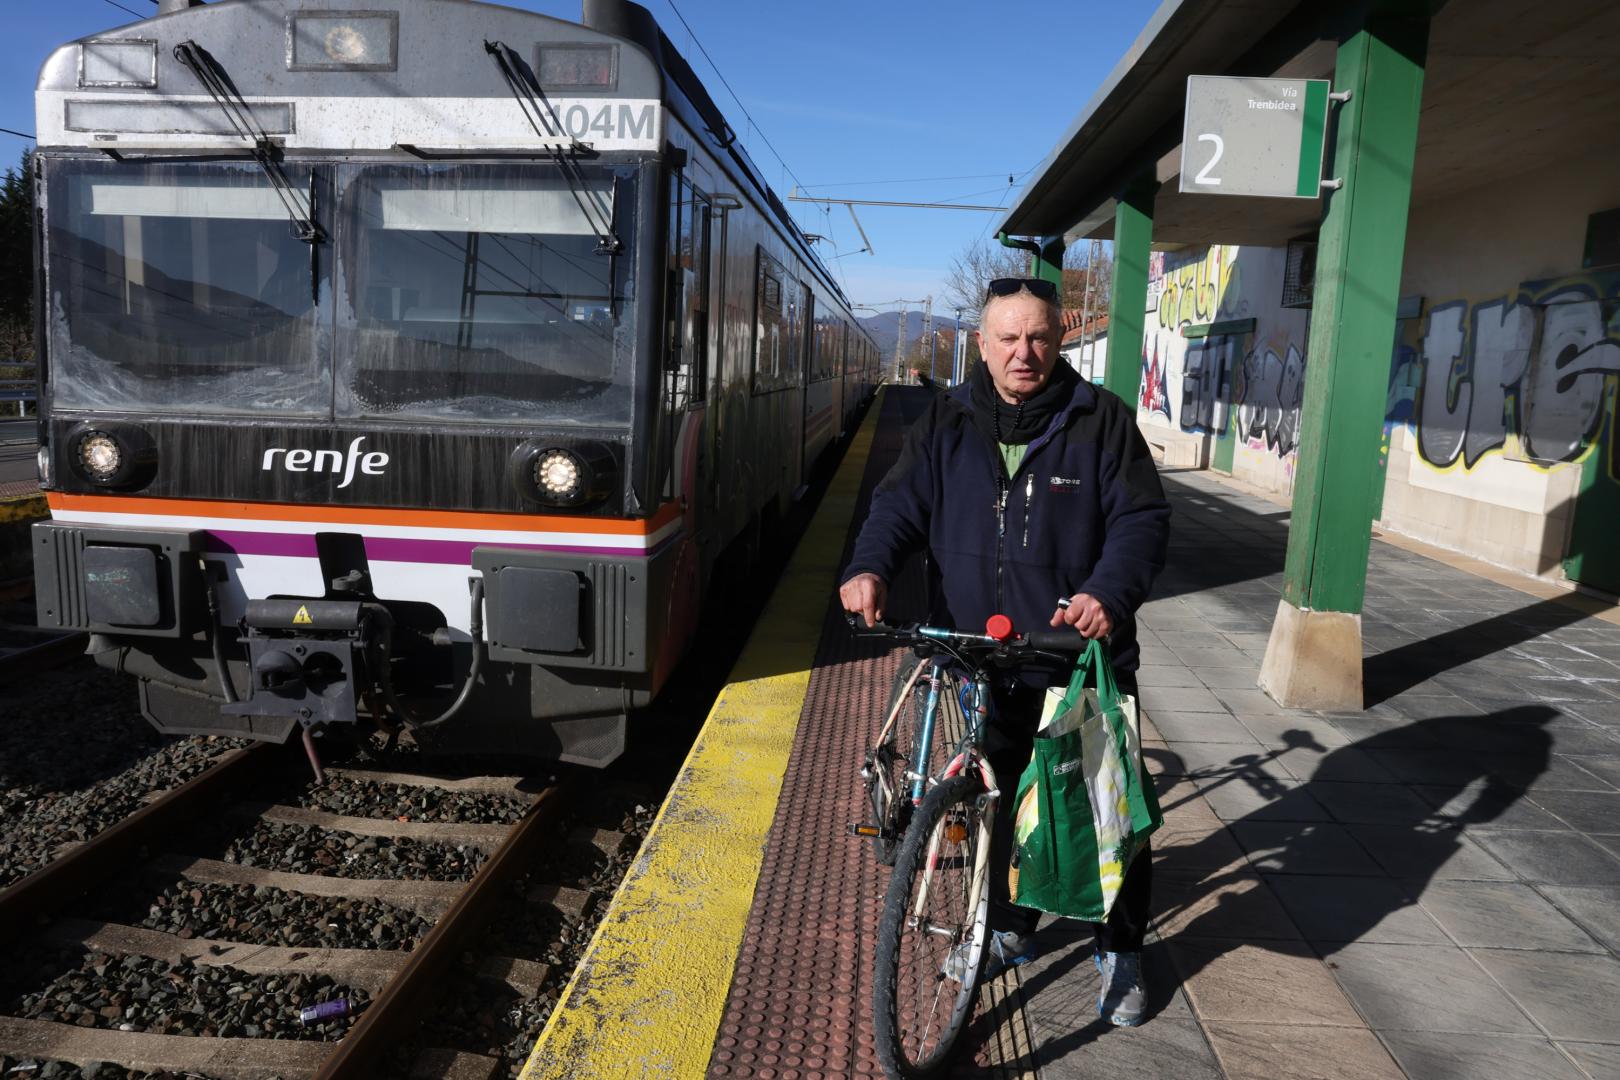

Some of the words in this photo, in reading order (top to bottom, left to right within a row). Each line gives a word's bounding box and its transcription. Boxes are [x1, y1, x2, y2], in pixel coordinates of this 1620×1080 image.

[1247, 99, 1296, 111] Trenbidea
[1195, 133, 1224, 185] 2
[262, 436, 389, 488] renfe
